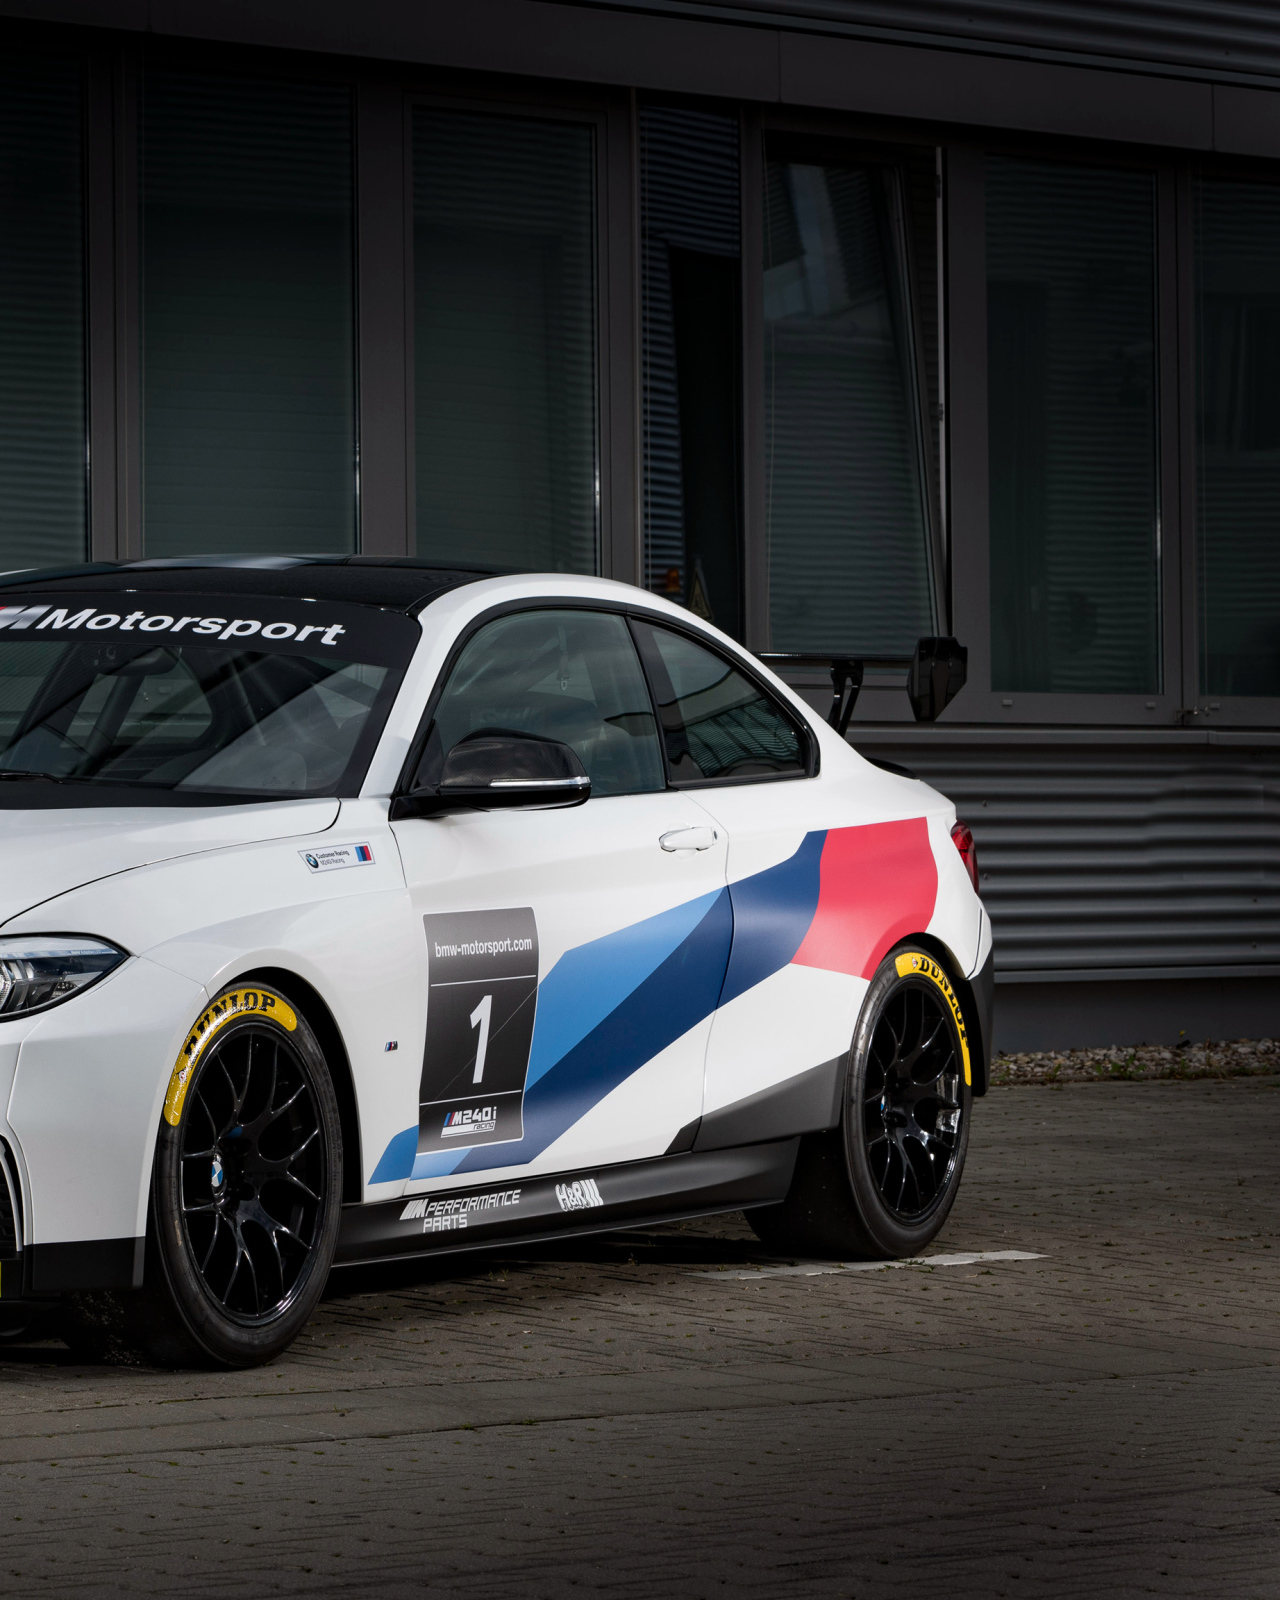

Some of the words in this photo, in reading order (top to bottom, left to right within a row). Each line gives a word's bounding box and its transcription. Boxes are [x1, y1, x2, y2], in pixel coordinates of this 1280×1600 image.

[35, 608, 346, 645] Motorsport
[435, 938, 532, 957] bmw-motorsport.com
[470, 995, 492, 1084] 1
[451, 1106, 497, 1125] M240i
[473, 1121, 495, 1130] racing
[425, 1189, 521, 1217] PERFORMANCE
[422, 1214, 468, 1233] PARTS
